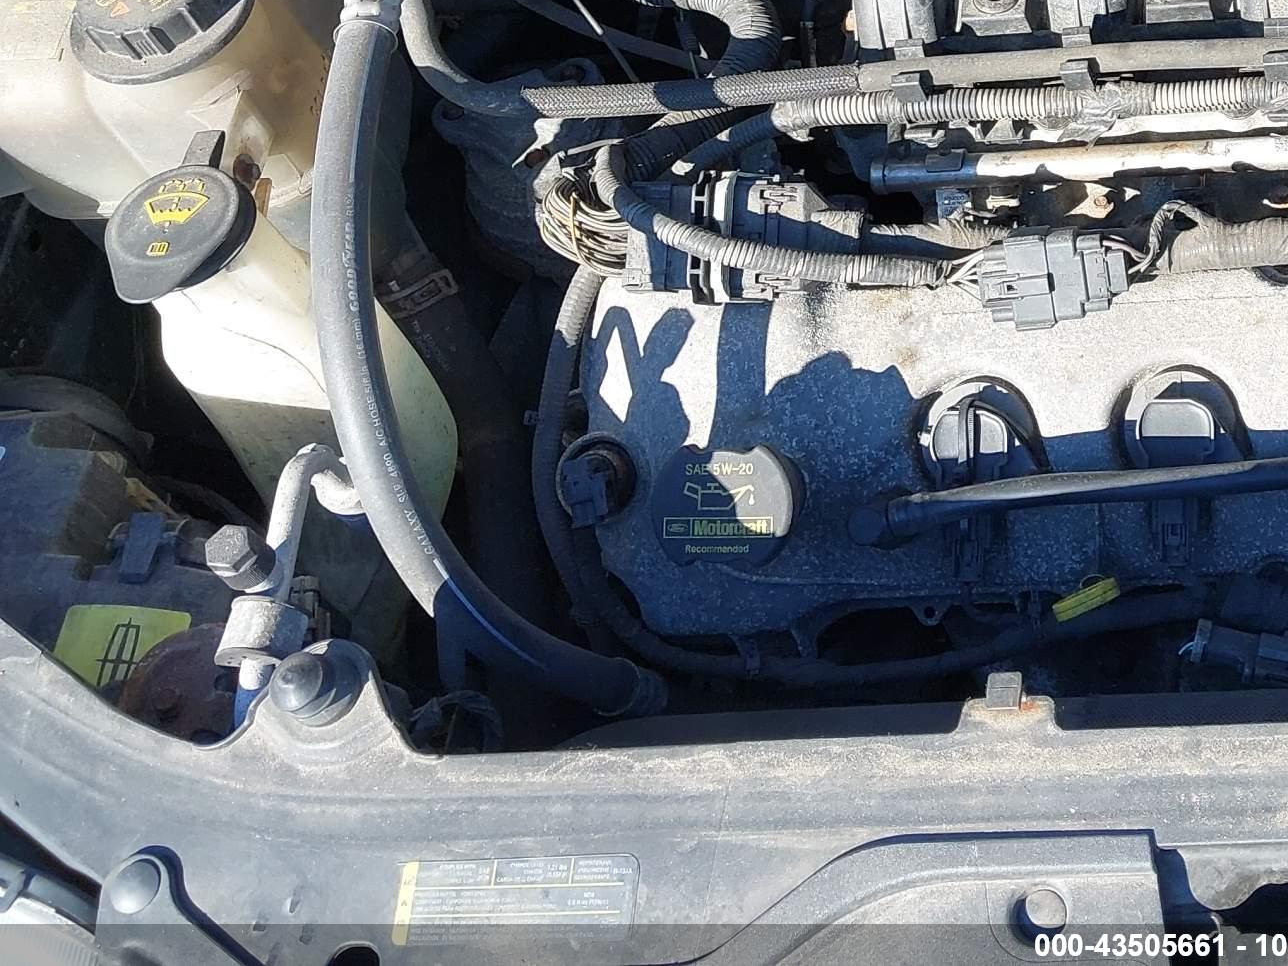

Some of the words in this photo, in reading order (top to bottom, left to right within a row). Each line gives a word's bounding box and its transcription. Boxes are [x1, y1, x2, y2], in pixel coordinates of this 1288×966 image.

[366, 397, 381, 427] HOSE
[376, 428, 387, 446] A/C
[384, 452, 398, 477] 4890
[686, 464, 708, 475] SAE
[713, 463, 754, 475] 5W-20
[404, 508, 435, 554] GALAXY
[694, 520, 768, 536] Motorcraft
[685, 544, 750, 554] Recommended
